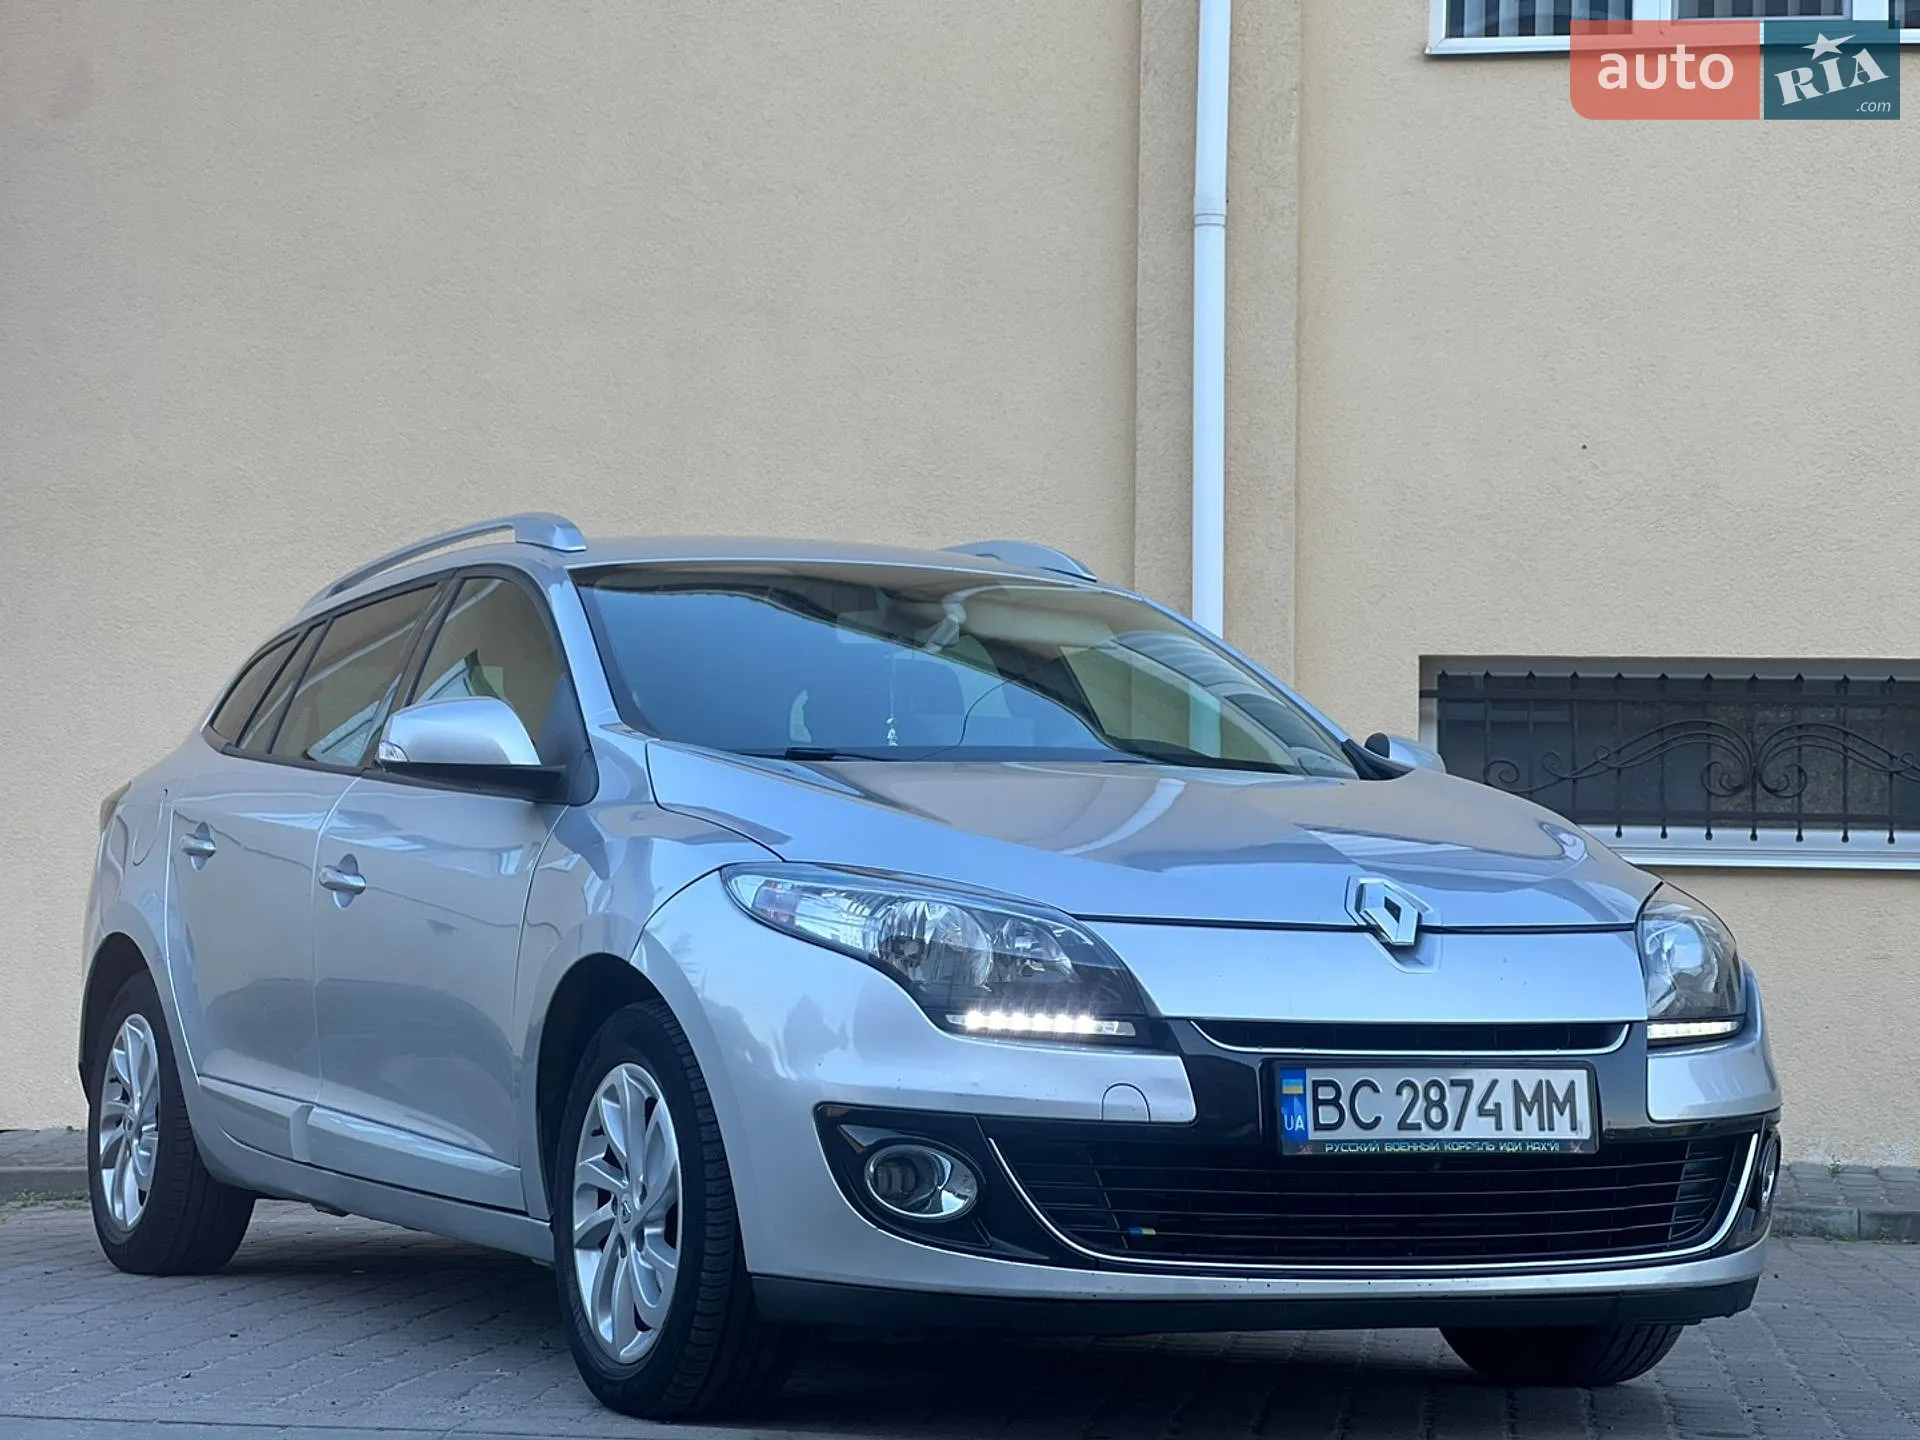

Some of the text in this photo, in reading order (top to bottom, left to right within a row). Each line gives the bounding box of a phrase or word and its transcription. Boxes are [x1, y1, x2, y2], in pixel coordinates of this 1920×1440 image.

[1311, 1078, 1579, 1133] BC 2874 MM
[1284, 1114, 1306, 1132] UA
[1325, 1141, 1380, 1153] РУССКИЙ
[1499, 1141, 1523, 1153] ИДИ
